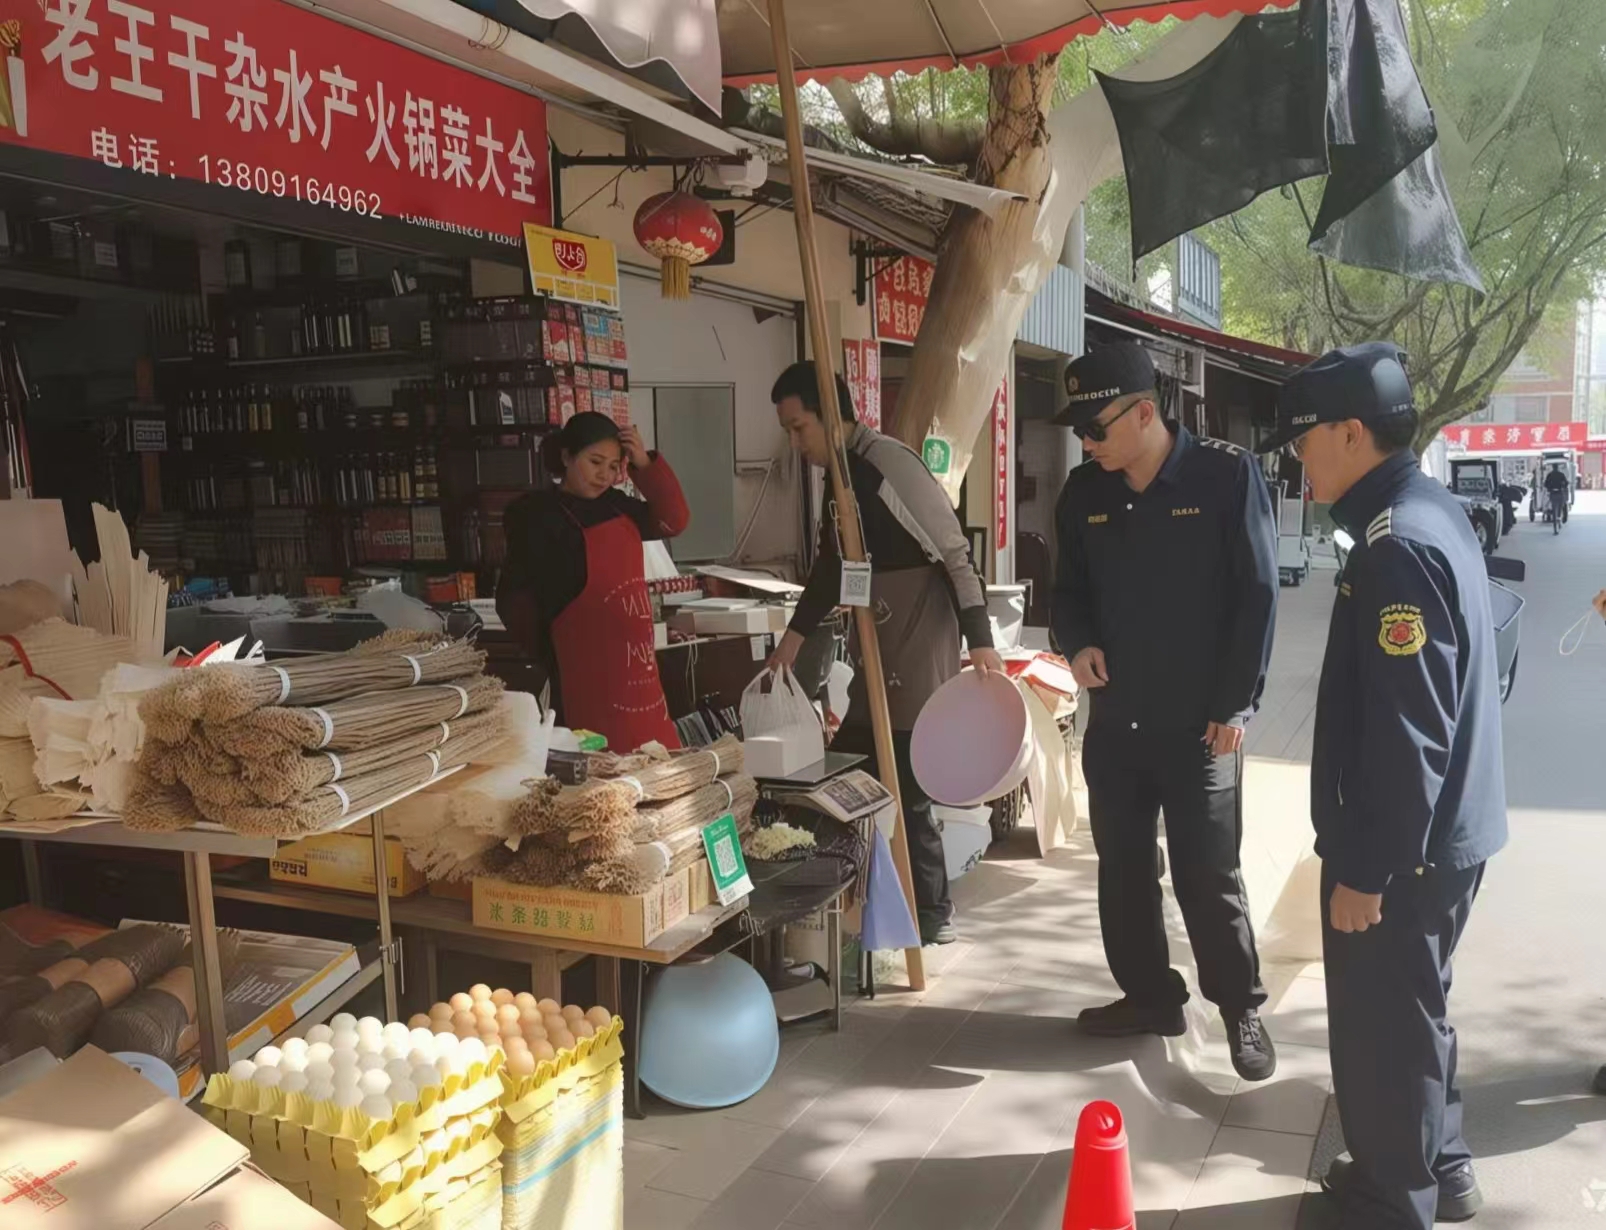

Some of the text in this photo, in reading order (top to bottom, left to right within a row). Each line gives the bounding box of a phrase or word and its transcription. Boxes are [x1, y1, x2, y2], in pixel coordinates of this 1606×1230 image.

[40, 0, 536, 204] 老王干杂水产火锅菜大全
[198, 155, 382, 219] 13809164962
